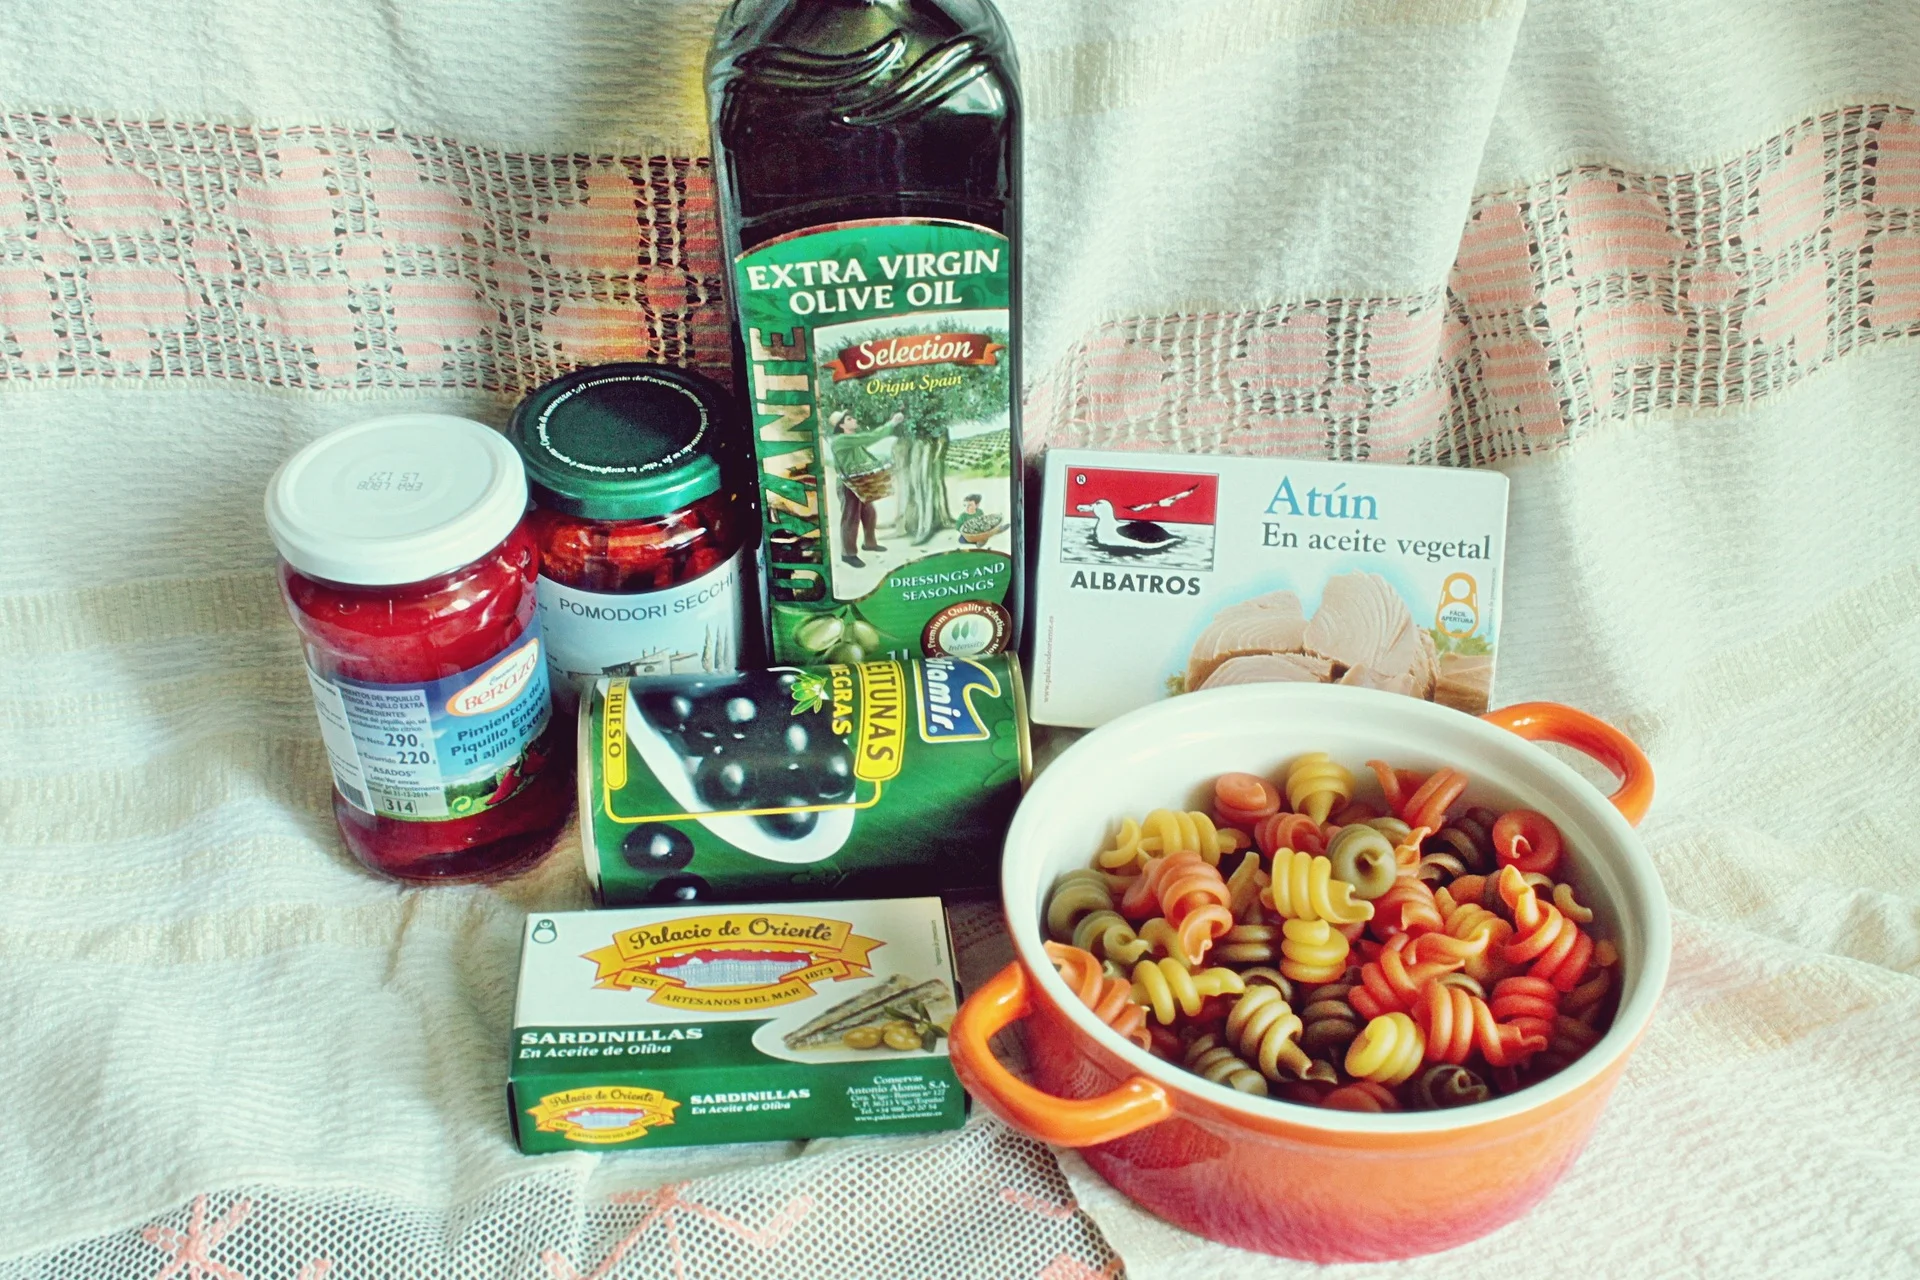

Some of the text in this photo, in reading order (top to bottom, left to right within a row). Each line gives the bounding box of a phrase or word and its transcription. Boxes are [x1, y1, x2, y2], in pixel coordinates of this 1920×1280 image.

[746, 249, 1000, 291] EXTRA VIRGIN
[789, 281, 963, 316] OLIVE OIL
[856, 335, 974, 370] Selection
[866, 373, 962, 398] Origin Spain
[749, 327, 827, 601] URZANTE
[1264, 475, 1379, 521] Atún
[1261, 521, 1492, 562] En aceite vegetal
[890, 562, 1006, 589] DRESSINGS AND
[1070, 571, 1201, 596] ALBATROS
[559, 571, 734, 622] POMODORI SECCHI
[902, 578, 995, 601] SEASONINGS
[927, 615, 948, 648] Premium
[948, 603, 984, 616] Quality
[457, 678, 542, 742] Pimientos del
[608, 679, 625, 759] IN HUESO
[866, 661, 898, 761] EITUNAS
[385, 733, 418, 747] 290
[450, 728, 508, 757] Piquillo
[465, 753, 478, 766] al
[483, 736, 516, 759] ajillo
[396, 750, 431, 765] 220
[385, 799, 413, 813] 314
[629, 917, 833, 950] Palacio de Oriente
[631, 967, 834, 987] EST. 1873
[663, 988, 801, 1007] ARTESANOS DEL MAR
[520, 1028, 704, 1046] SARDINILLAS
[519, 1043, 672, 1059] En Aceite de Oliva
[846, 1086, 888, 1095] Antonio
[873, 1075, 924, 1085] Conservas
[549, 1091, 593, 1107] Palacio
[595, 1090, 607, 1100] de
[690, 1088, 811, 1105] SARDINILLAS
[691, 1101, 791, 1115] En Aceite de Oliva
